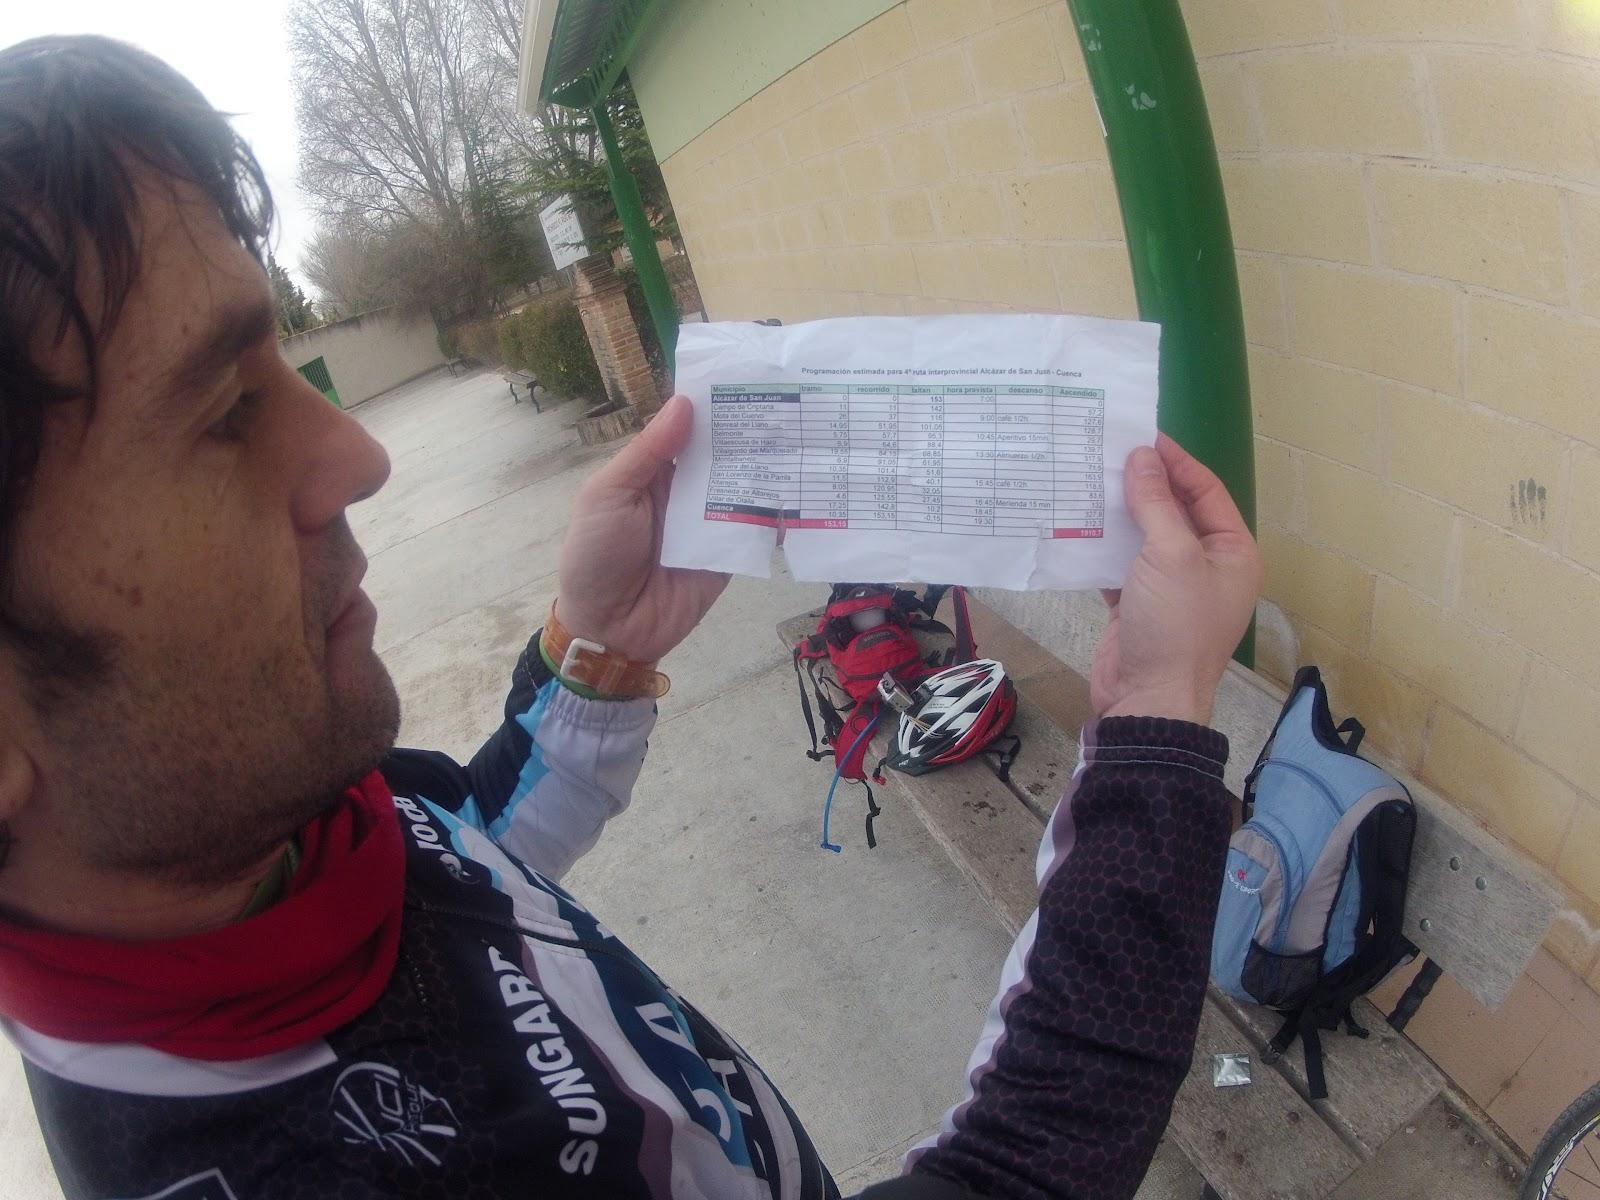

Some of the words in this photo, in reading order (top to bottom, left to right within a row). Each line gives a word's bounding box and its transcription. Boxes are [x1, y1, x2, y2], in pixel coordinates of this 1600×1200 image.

[802, 367, 851, 376] Programación
[928, 368, 978, 376] interprovincial
[1056, 369, 1082, 377] Cuenca
[1060, 389, 1097, 397] Ascendido
[713, 403, 736, 411] Campo
[747, 403, 774, 411] Criptana
[998, 434, 1027, 442] Aperitivo
[711, 479, 738, 487] Altarejos
[751, 490, 780, 499] Altarejos
[996, 500, 1027, 508] Merienda
